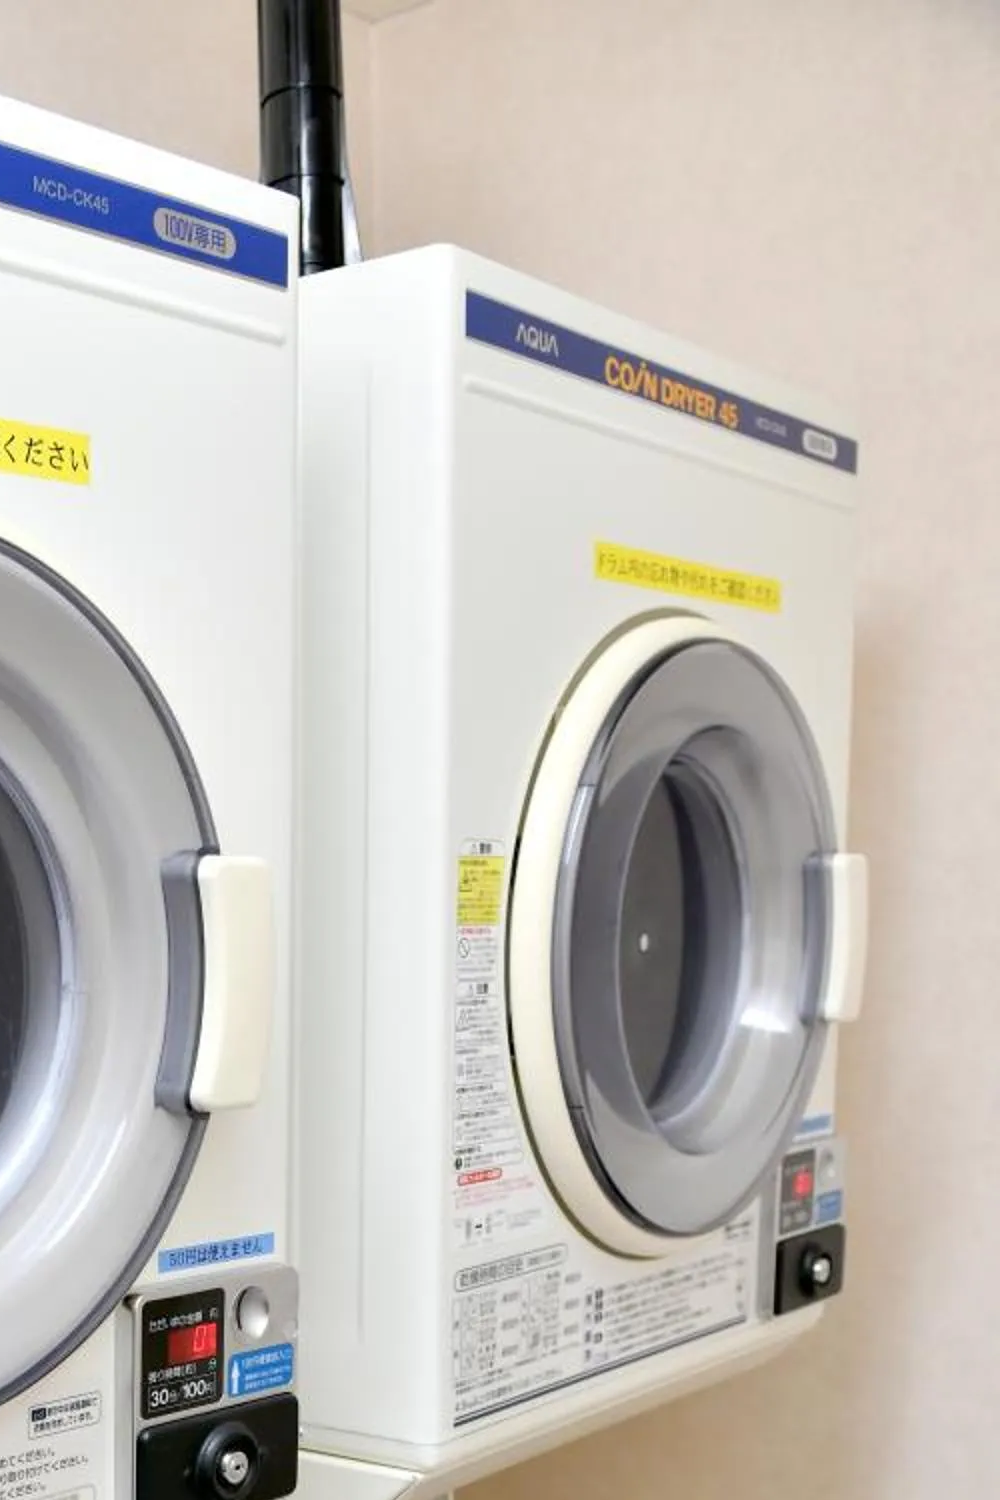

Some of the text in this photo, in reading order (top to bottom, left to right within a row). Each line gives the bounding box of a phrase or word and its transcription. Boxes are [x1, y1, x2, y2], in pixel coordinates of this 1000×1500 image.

[32, 175, 109, 215] MCD-CK45
[164, 213, 227, 254] 100V専用
[516, 323, 558, 358] AQUA
[661, 379, 716, 421] DRYER
[719, 404, 739, 430] 45
